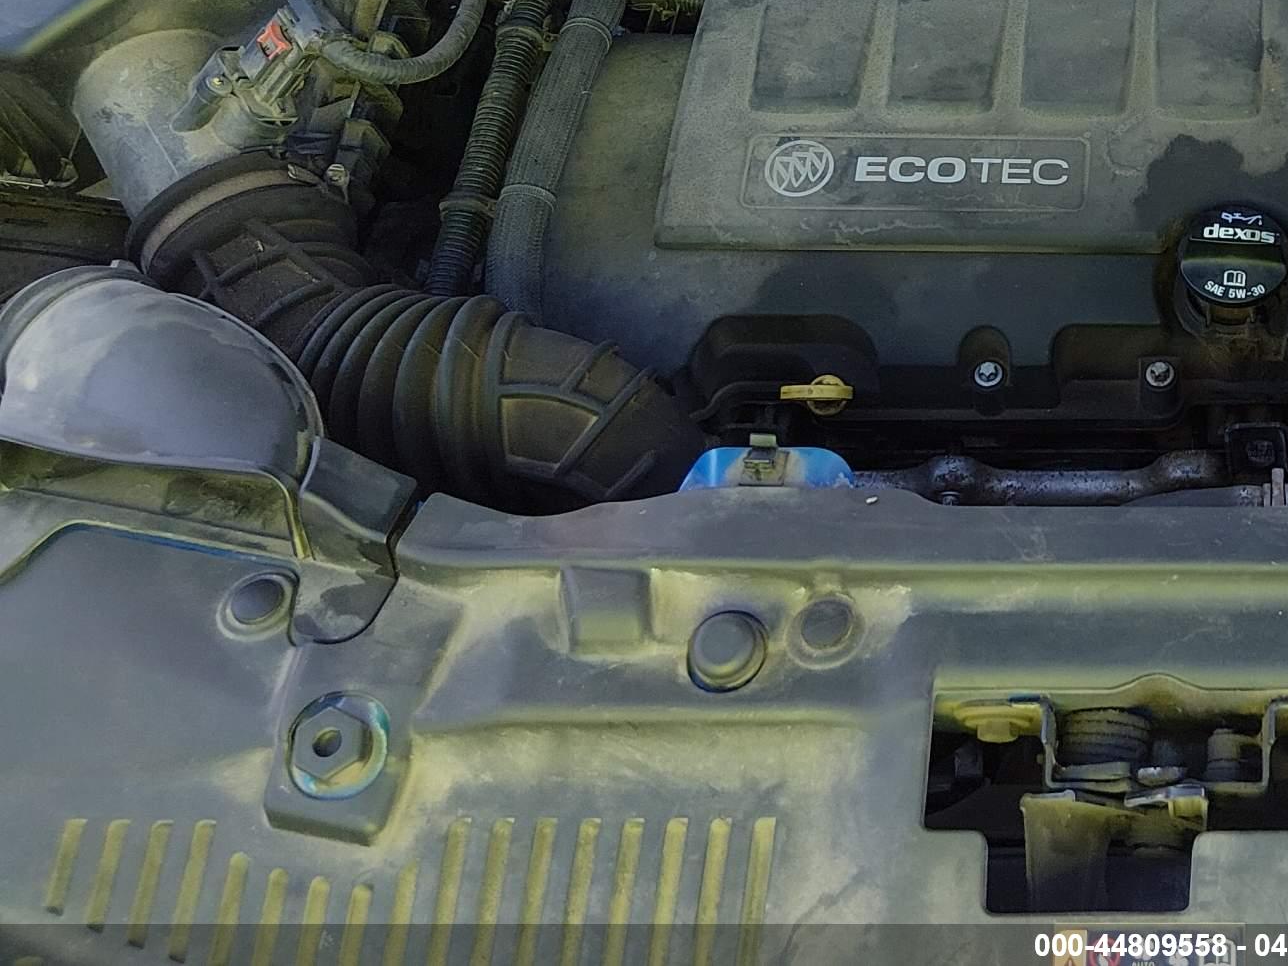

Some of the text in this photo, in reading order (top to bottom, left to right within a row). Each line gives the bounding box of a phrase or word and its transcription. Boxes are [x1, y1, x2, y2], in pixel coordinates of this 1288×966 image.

[854, 156, 1069, 184] ECOTEC
[1203, 223, 1276, 244] dexos
[1204, 280, 1266, 299] SAE 5W-30
